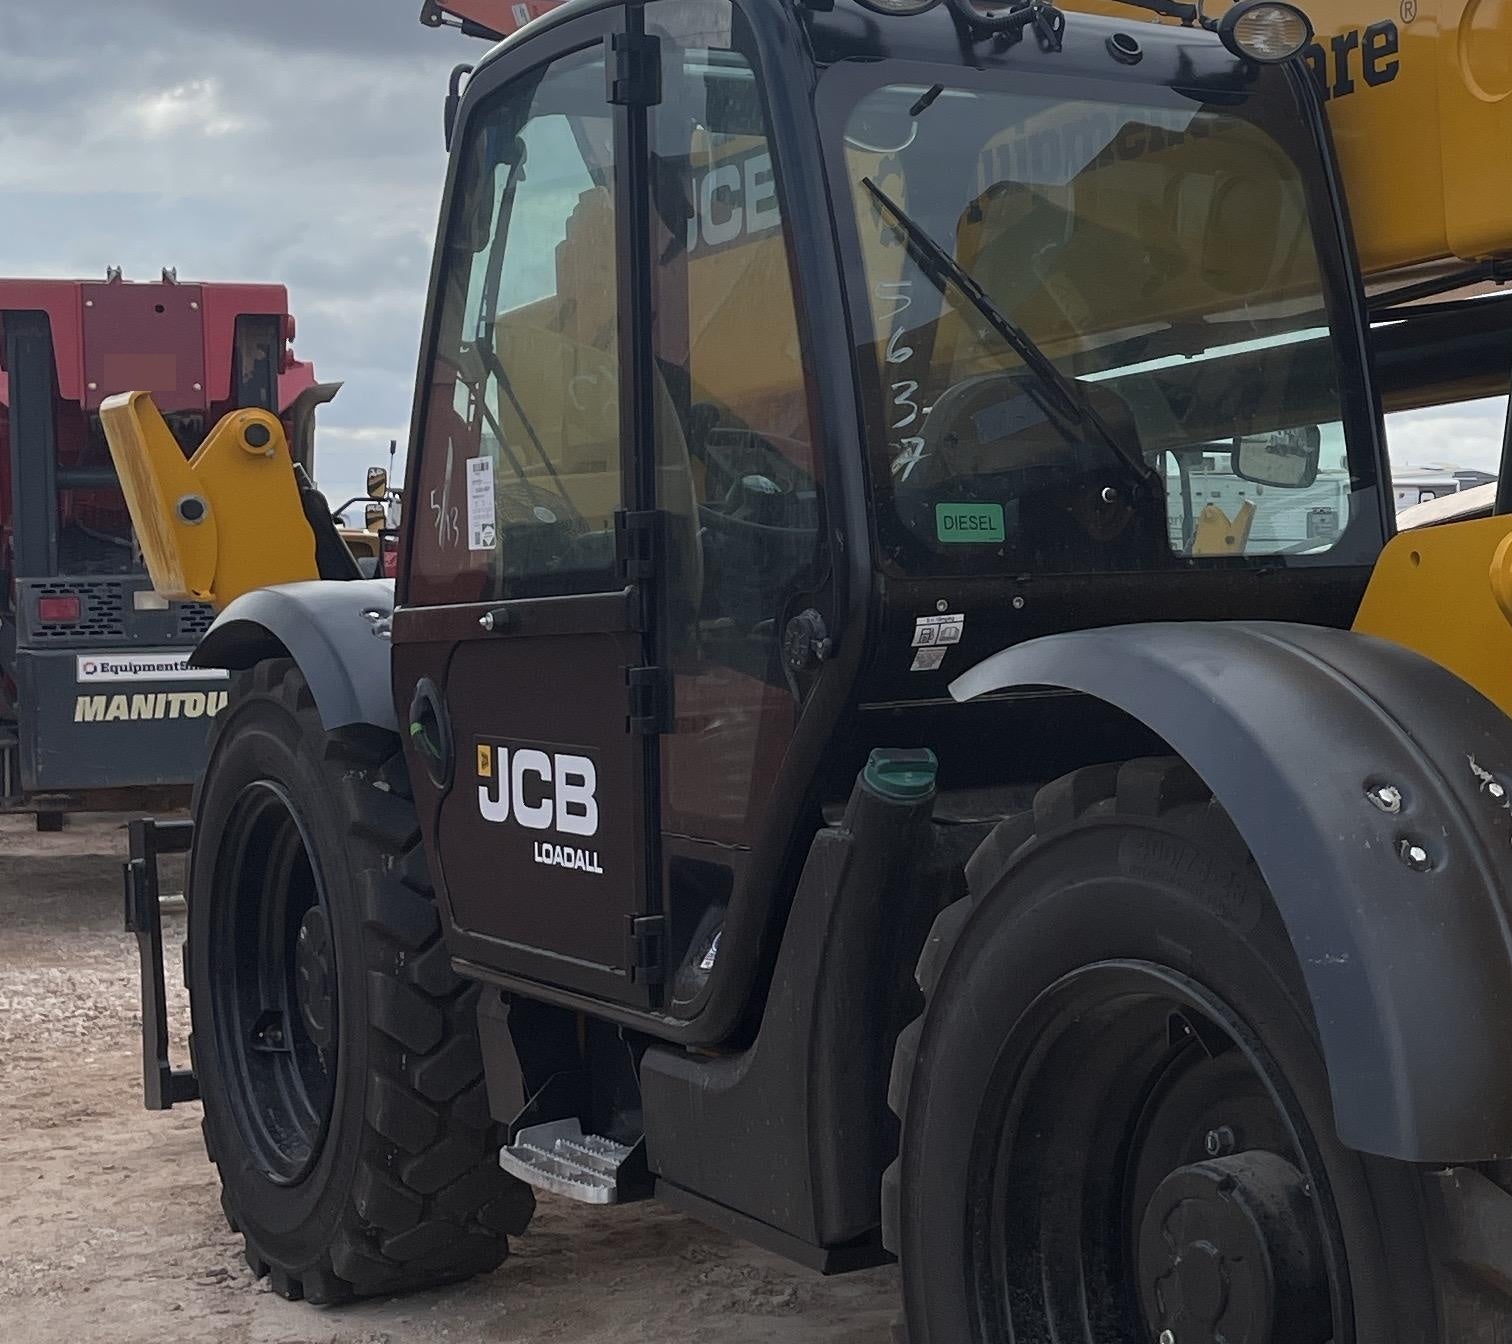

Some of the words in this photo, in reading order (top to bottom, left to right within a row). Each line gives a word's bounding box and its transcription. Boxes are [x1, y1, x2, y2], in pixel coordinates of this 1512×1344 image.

[943, 514, 998, 531] DIESEL
[74, 691, 229, 722] MANITOU
[478, 746, 599, 837] JCB
[534, 841, 604, 875] LOADALL
